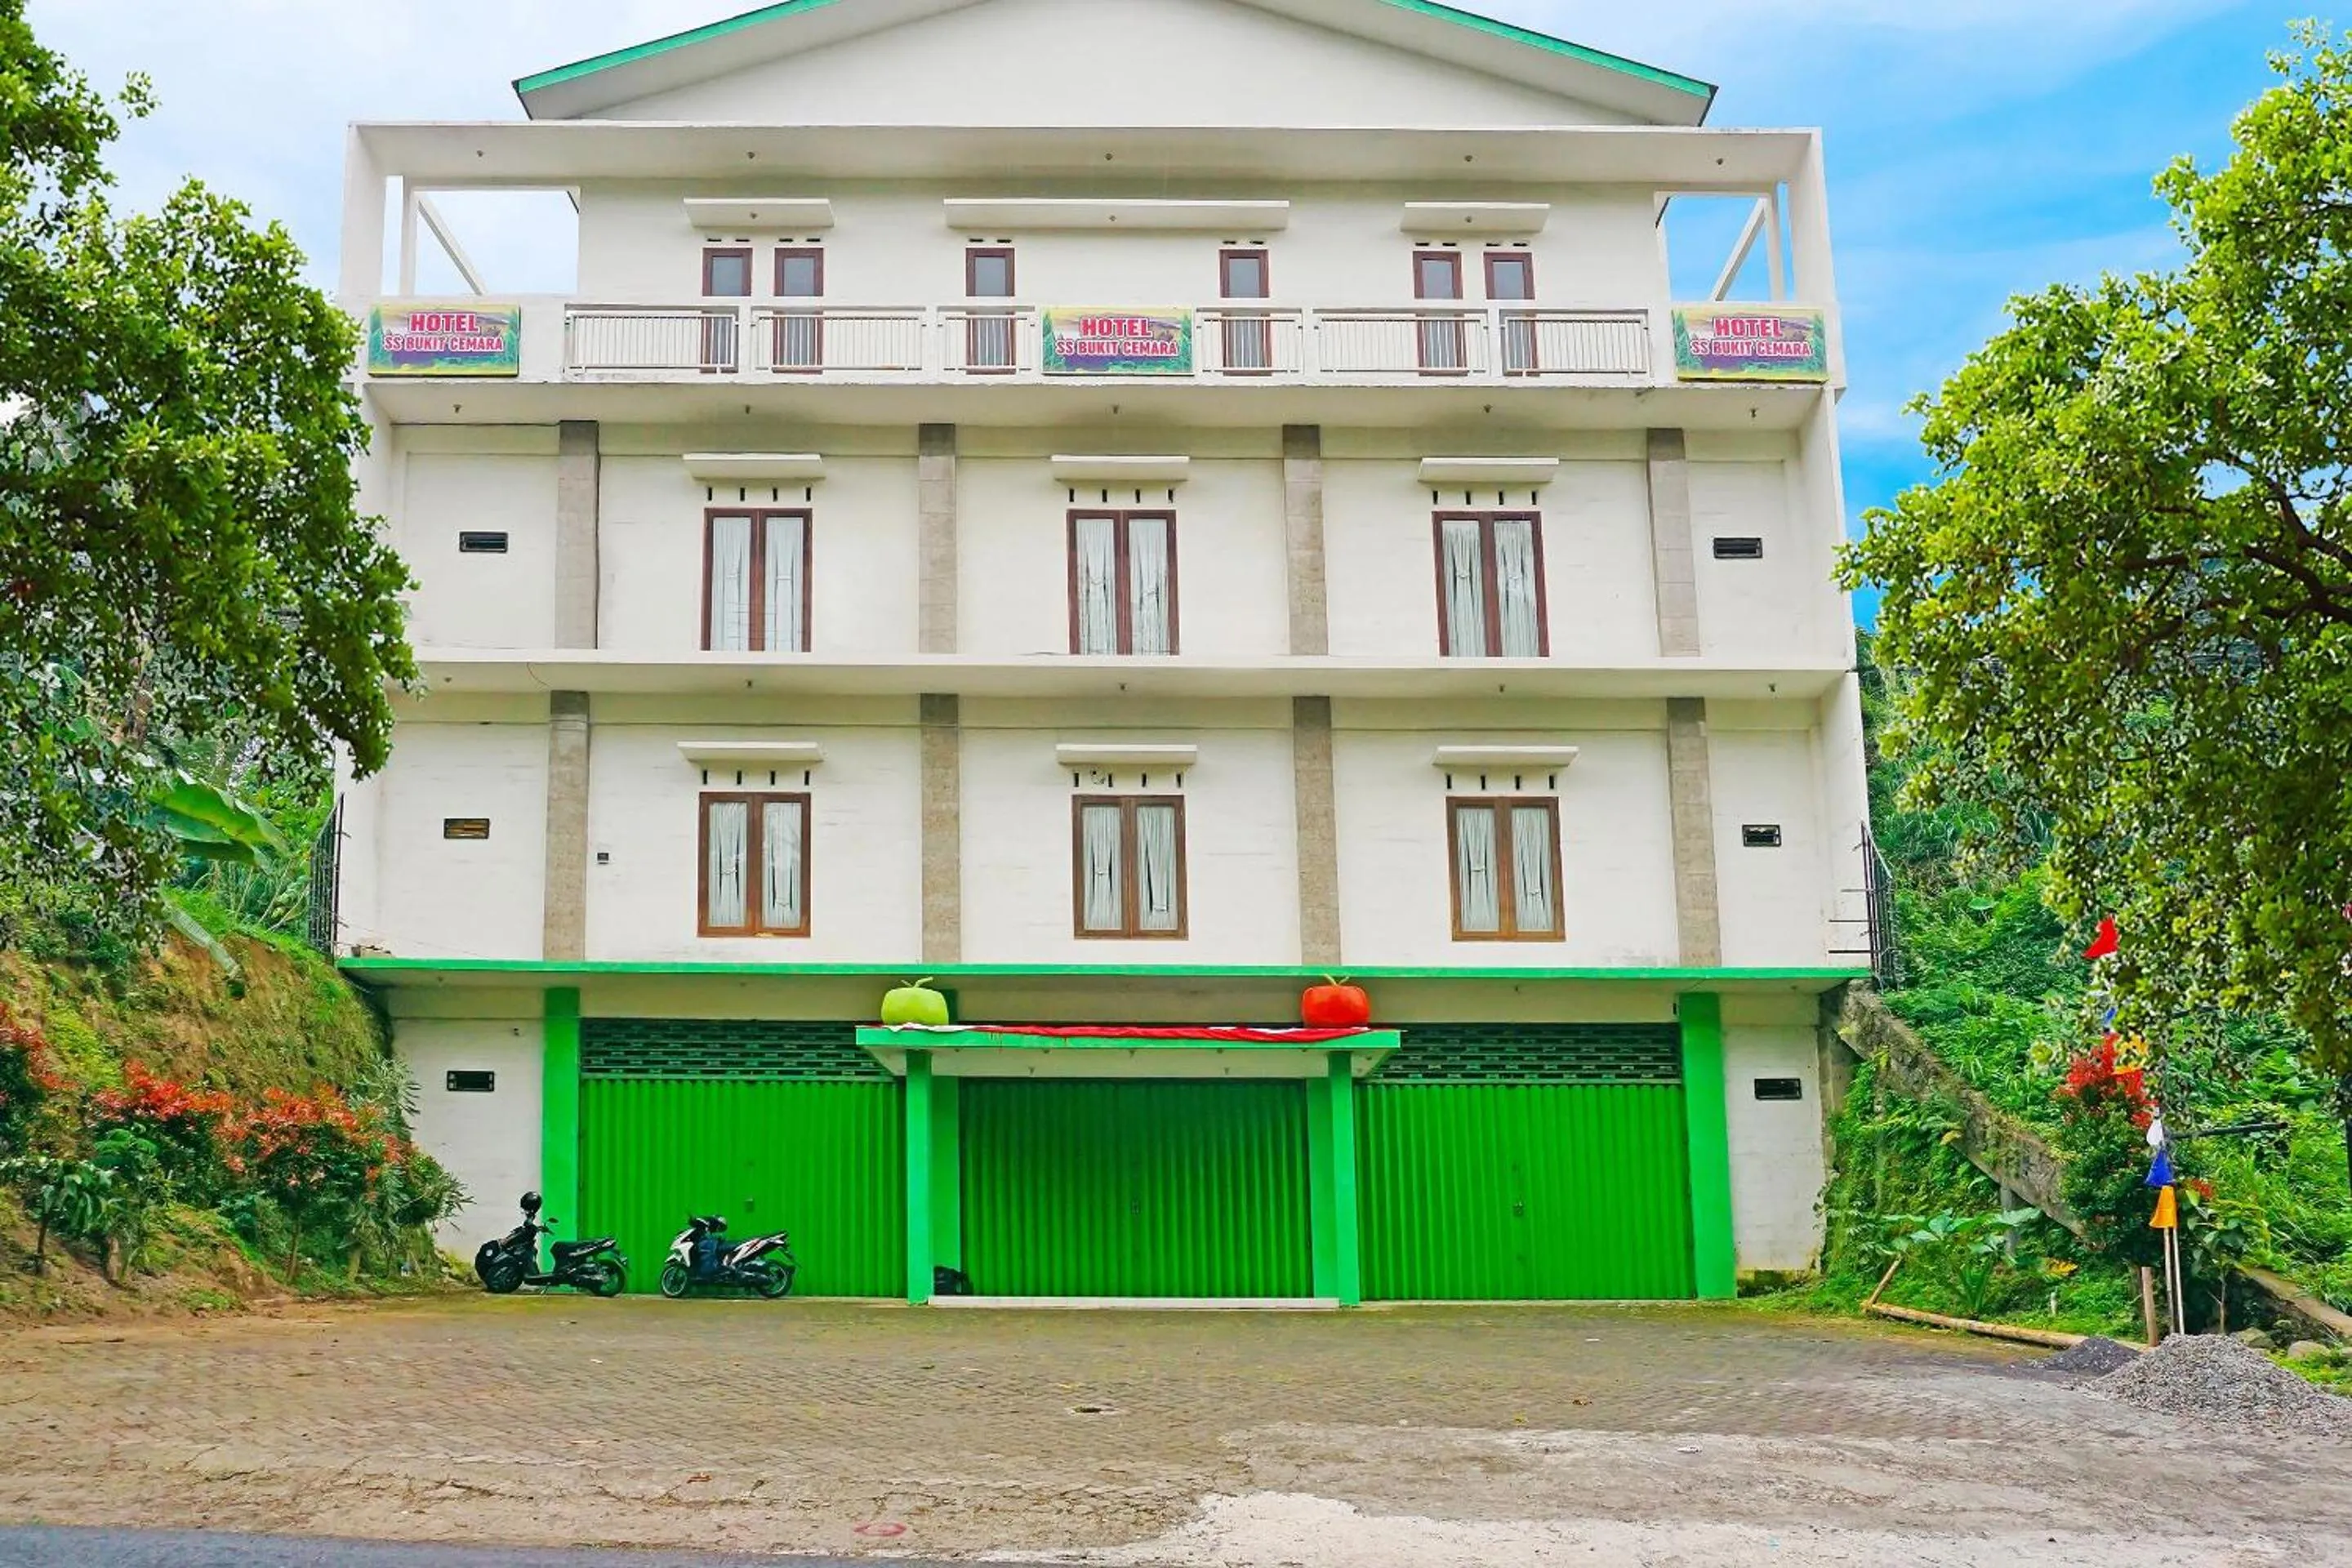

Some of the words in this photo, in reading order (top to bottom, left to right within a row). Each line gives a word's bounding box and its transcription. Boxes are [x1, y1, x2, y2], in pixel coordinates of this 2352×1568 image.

[410, 314, 479, 332] HOTEL
[1080, 318, 1152, 337] HOTEL
[1714, 318, 1784, 337] HOTEL
[385, 335, 402, 350] SS
[406, 336, 447, 351] BUKIT
[450, 336, 503, 351] CEMARA
[1057, 340, 1074, 355] SS
[1077, 341, 1119, 355] BUKIT
[1122, 341, 1178, 356] CEMARA
[1691, 340, 1709, 354] SS
[1712, 340, 1753, 355] BUKIT
[1756, 341, 1811, 356] CEMARA
